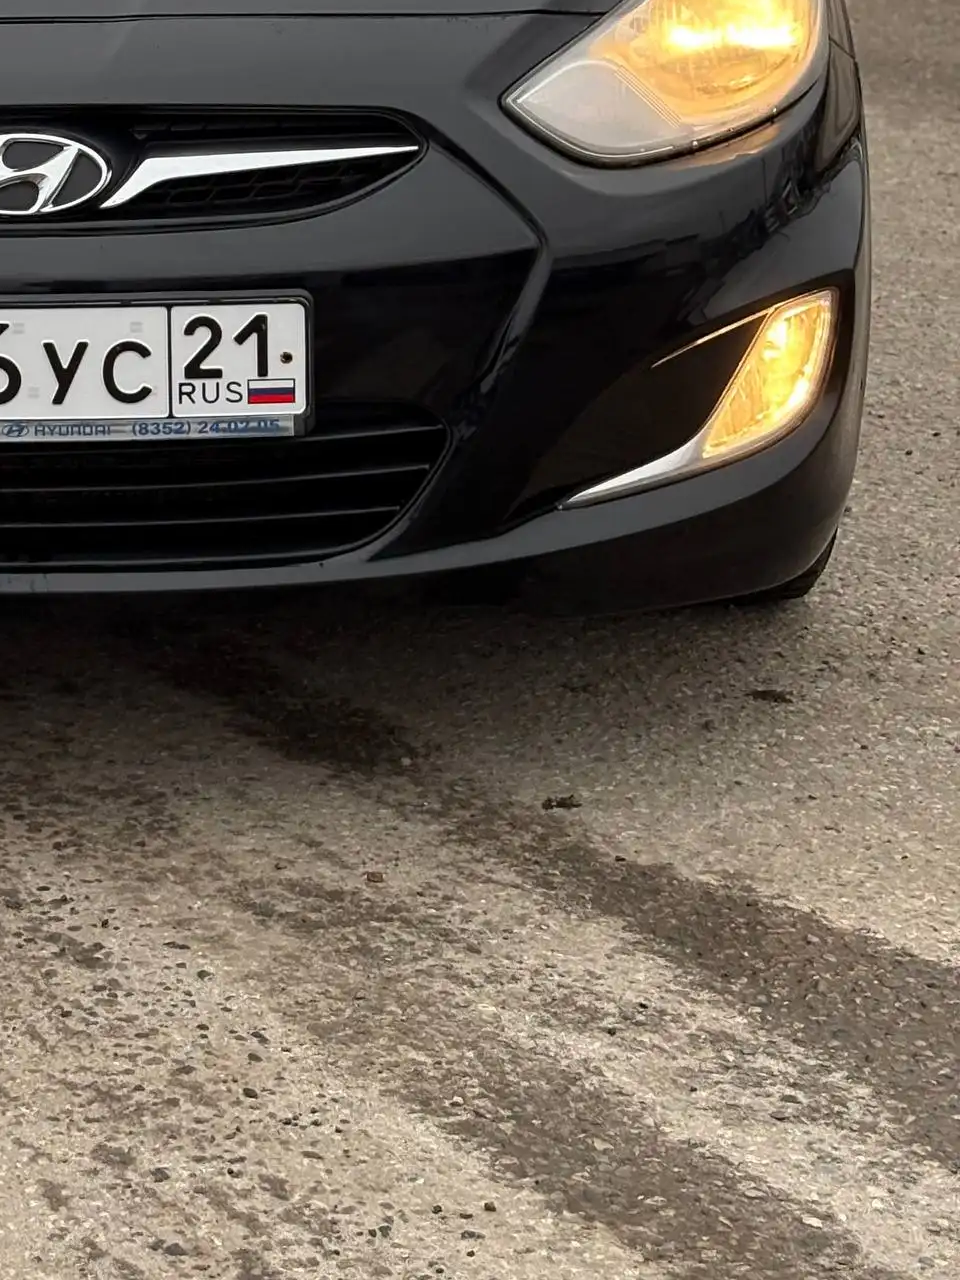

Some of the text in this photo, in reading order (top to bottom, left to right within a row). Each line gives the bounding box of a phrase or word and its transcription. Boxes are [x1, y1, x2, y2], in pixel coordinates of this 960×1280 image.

[183, 314, 269, 379] 21
[178, 381, 244, 404] RUS
[131, 421, 191, 436] (8352)
